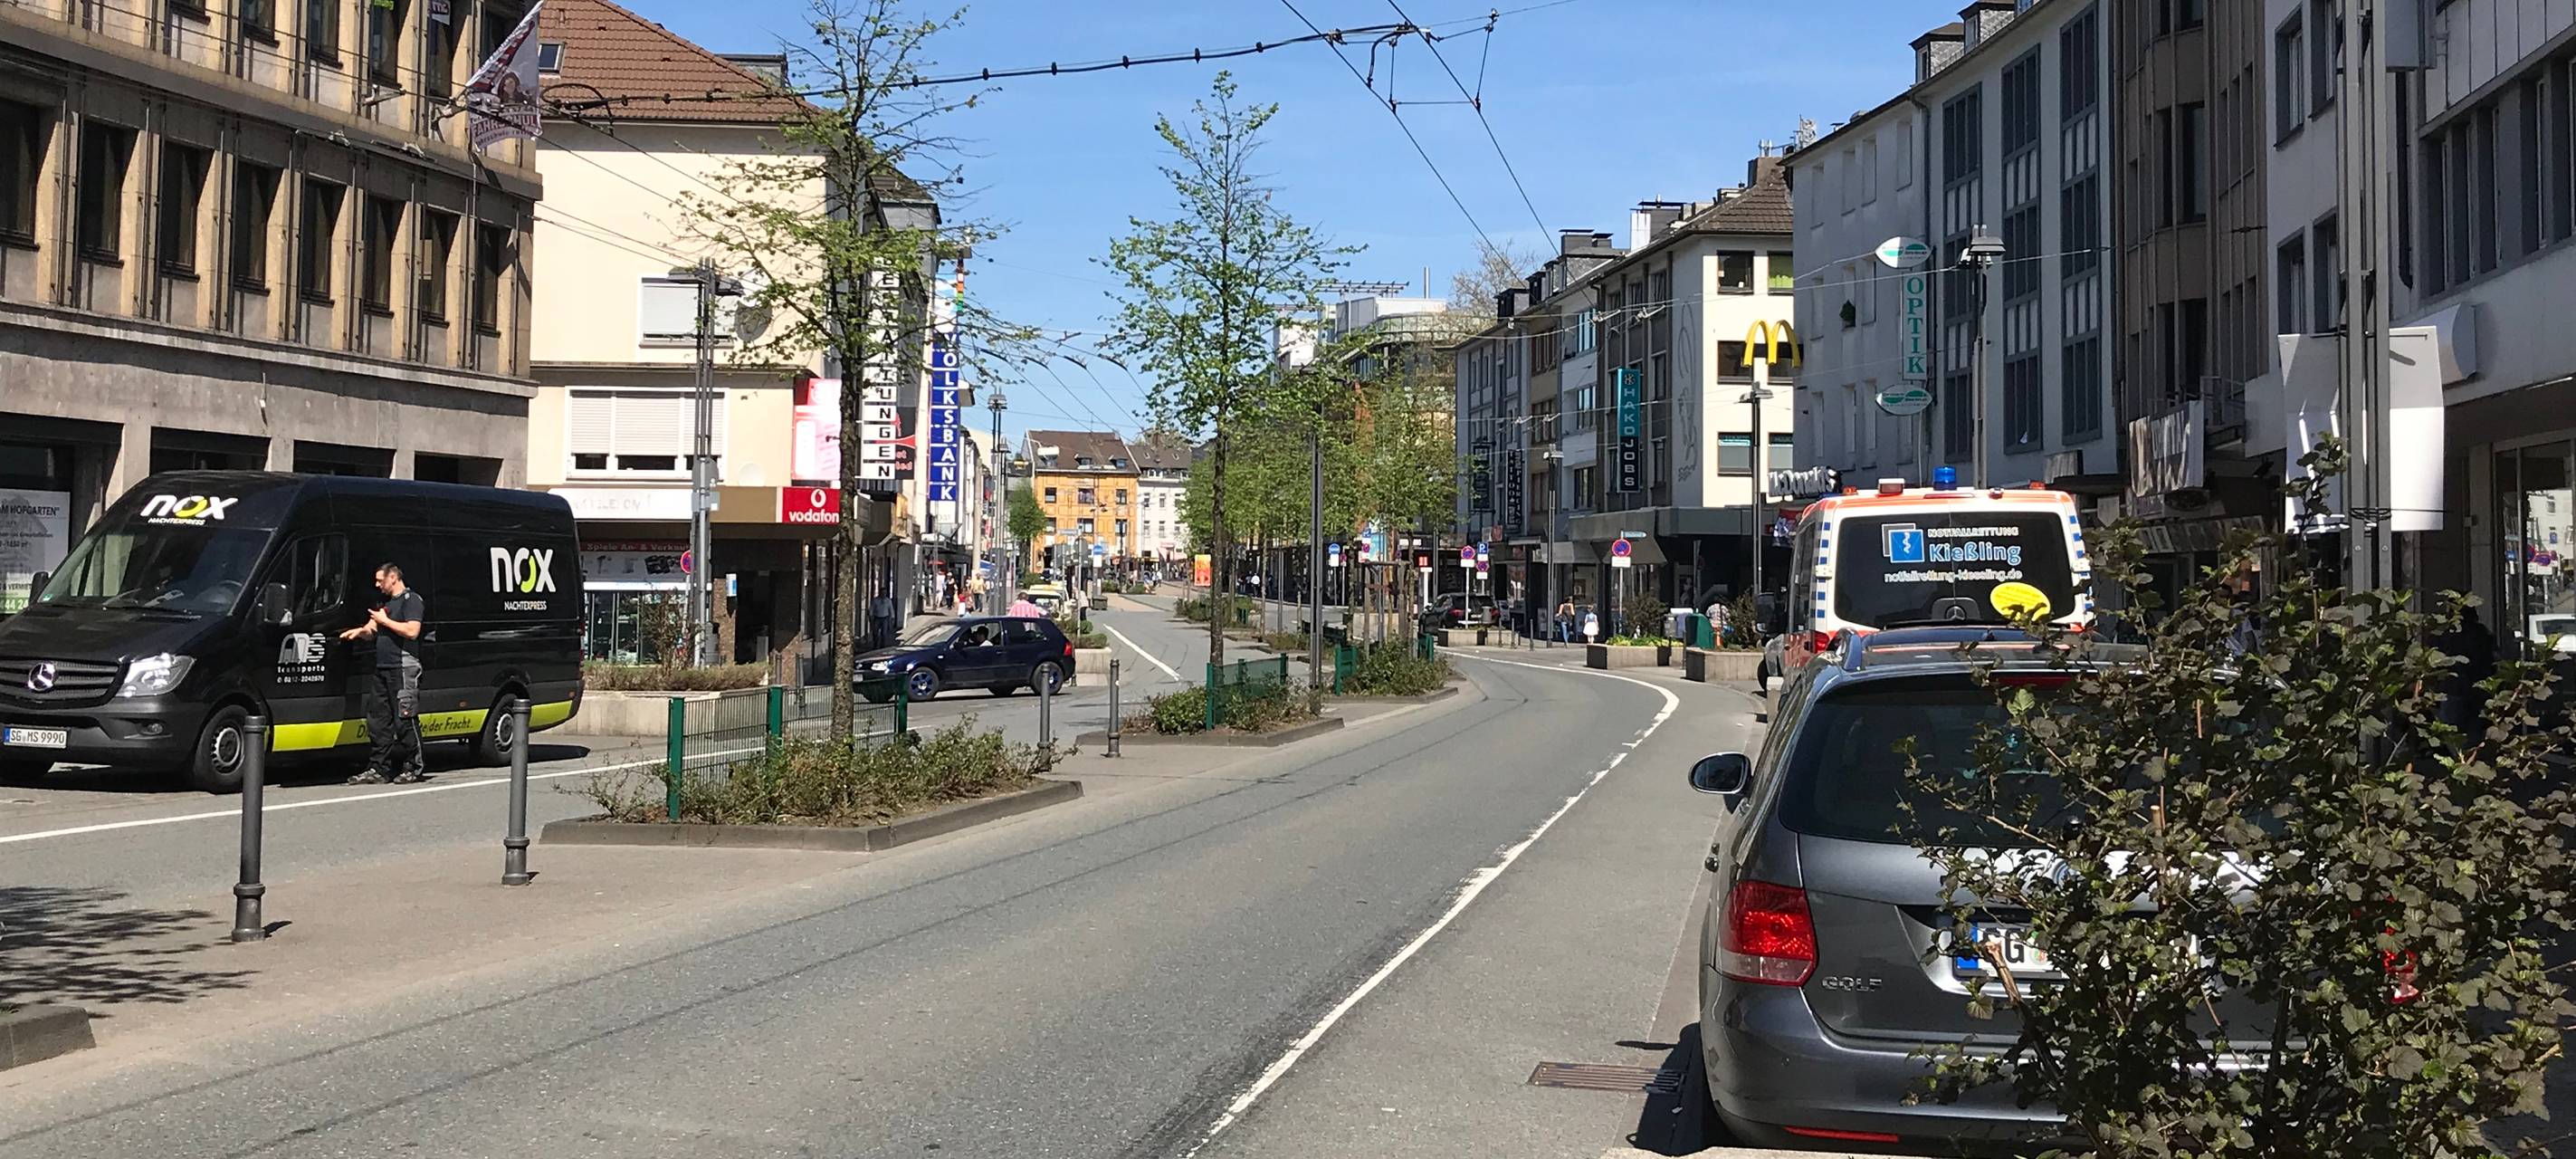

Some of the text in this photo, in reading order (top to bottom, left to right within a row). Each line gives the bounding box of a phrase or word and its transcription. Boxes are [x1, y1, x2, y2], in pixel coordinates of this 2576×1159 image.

[1906, 276, 1925, 375] OPTIK
[940, 333, 958, 500] VOLKSBANK
[1623, 388, 1636, 436] HAKO
[1623, 438, 1636, 486] JOBS
[139, 494, 239, 521] nox
[788, 509, 840, 523] vodafon
[148, 517, 206, 526] NACHTEXPRESS
[1927, 526, 2019, 538] NOTFALLRETTUNG
[1929, 541, 2022, 566] Kießling
[490, 546, 557, 593] nox
[1884, 568, 2023, 583] notfallrettung-kiessling.de
[504, 600, 548, 611] NACHTEXPRESS
[11, 730, 65, 744] SG MS 9990
[1822, 976, 1883, 992] GOLF
